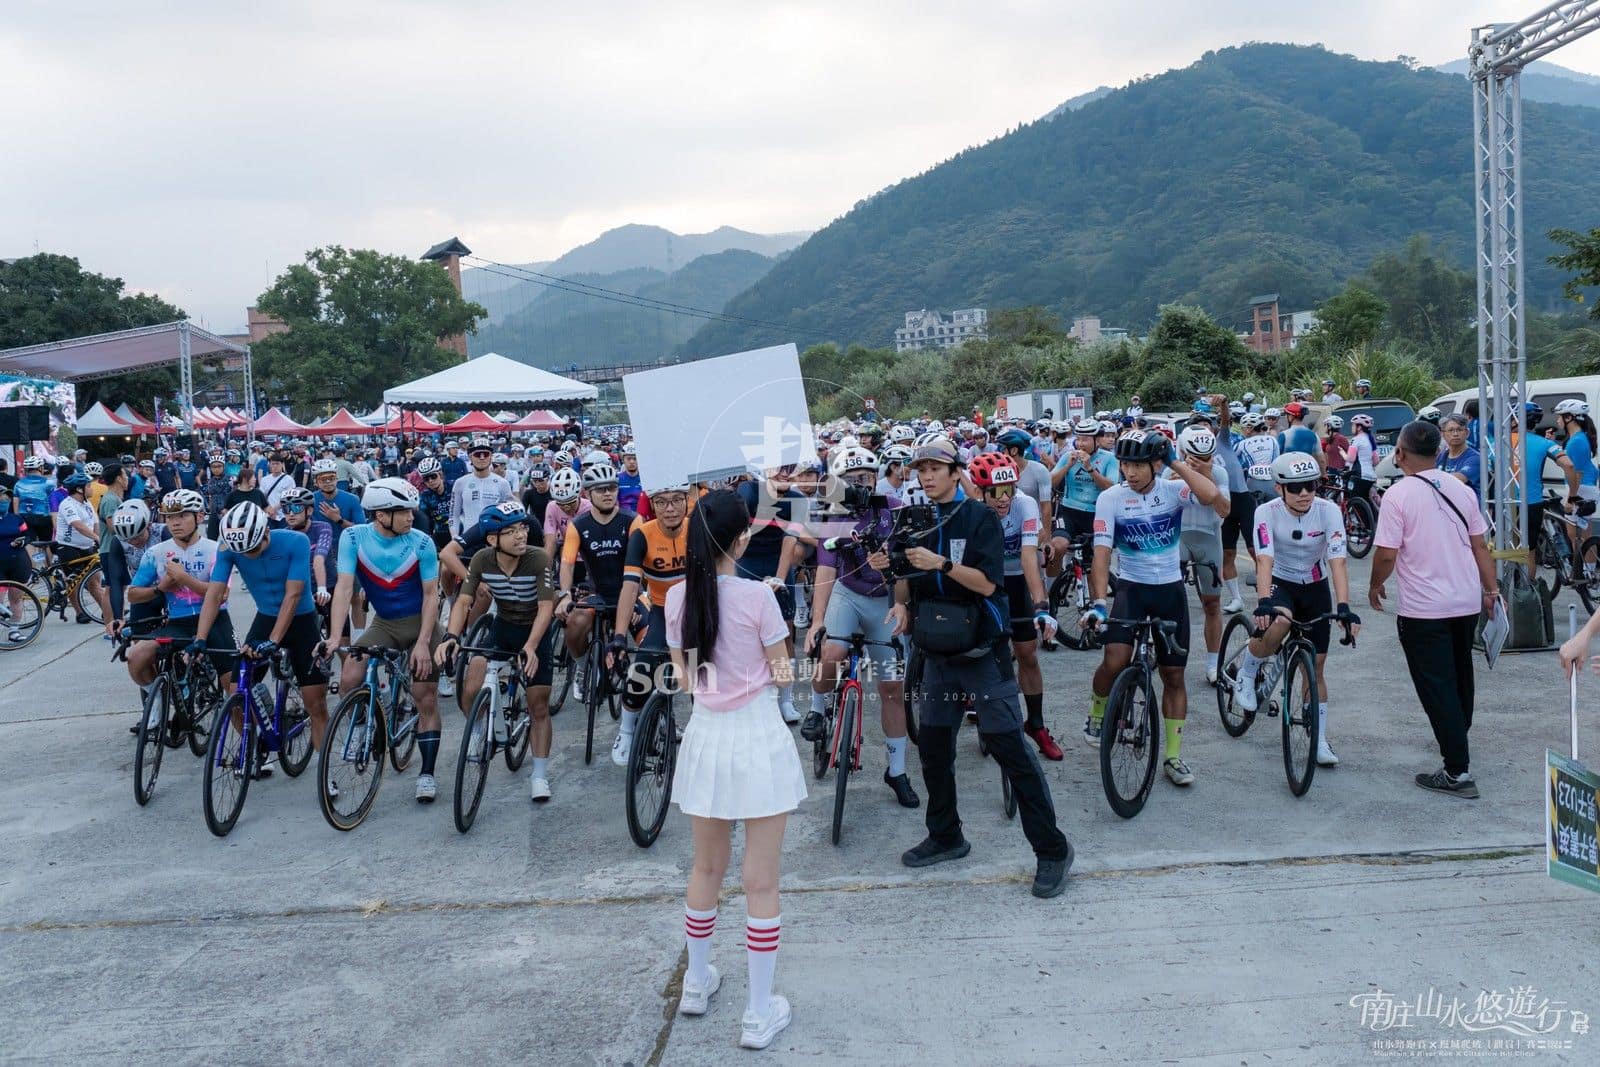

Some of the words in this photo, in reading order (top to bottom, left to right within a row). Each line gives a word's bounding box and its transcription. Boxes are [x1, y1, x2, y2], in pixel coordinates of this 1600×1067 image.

[1193, 436, 1210, 444] 412
[1293, 461, 1314, 473] 324
[995, 470, 1014, 481] 404
[555, 489, 569, 497] 421
[116, 515, 132, 524] 314
[226, 531, 245, 541] 420
[589, 539, 622, 550] e-MA
